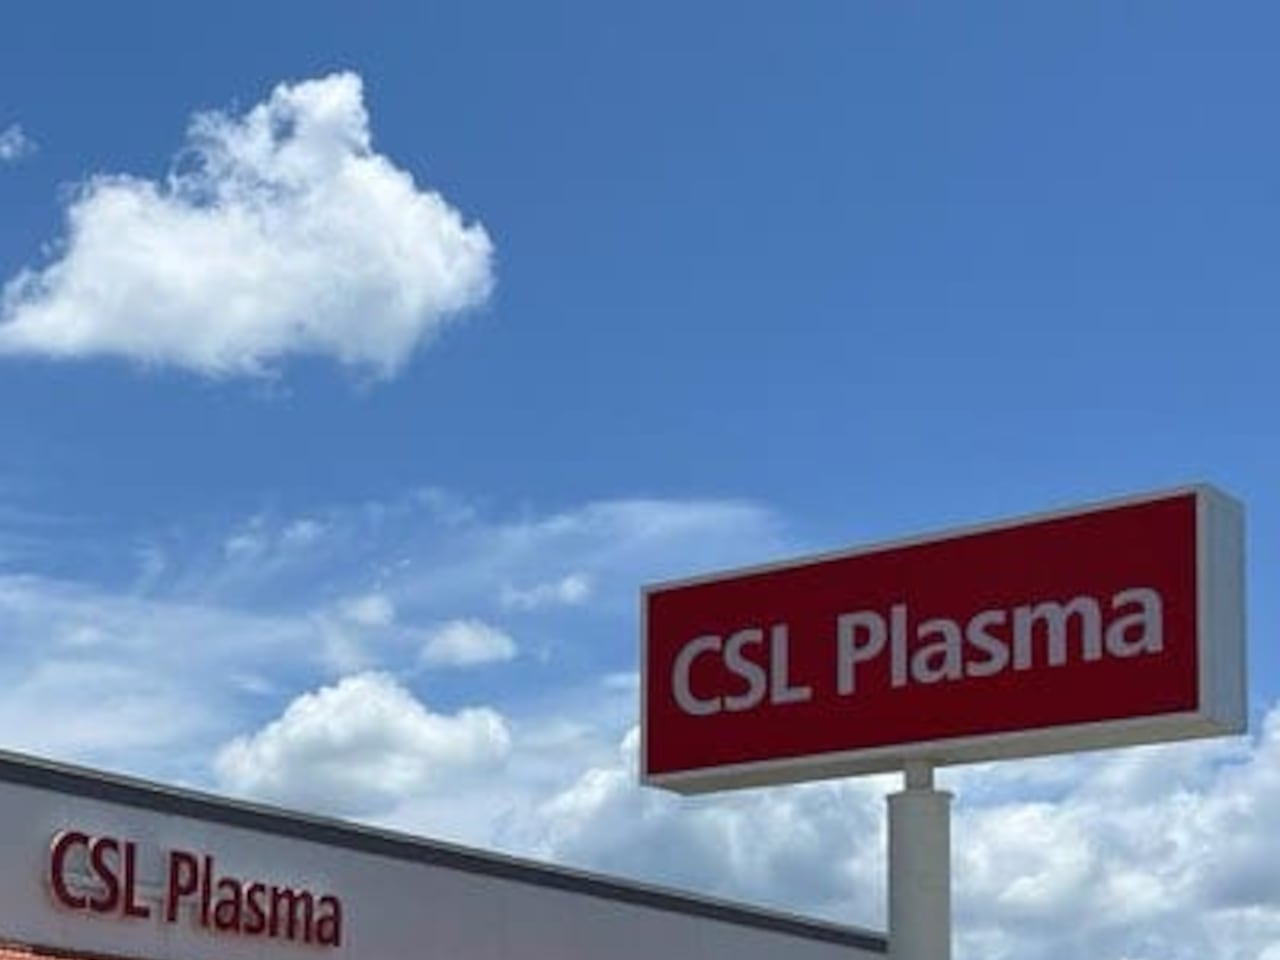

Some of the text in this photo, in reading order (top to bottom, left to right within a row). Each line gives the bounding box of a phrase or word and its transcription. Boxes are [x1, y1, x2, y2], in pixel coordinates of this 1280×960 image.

[672, 587, 1165, 716] CSL Plasma
[48, 829, 343, 948] CSL Plasma
